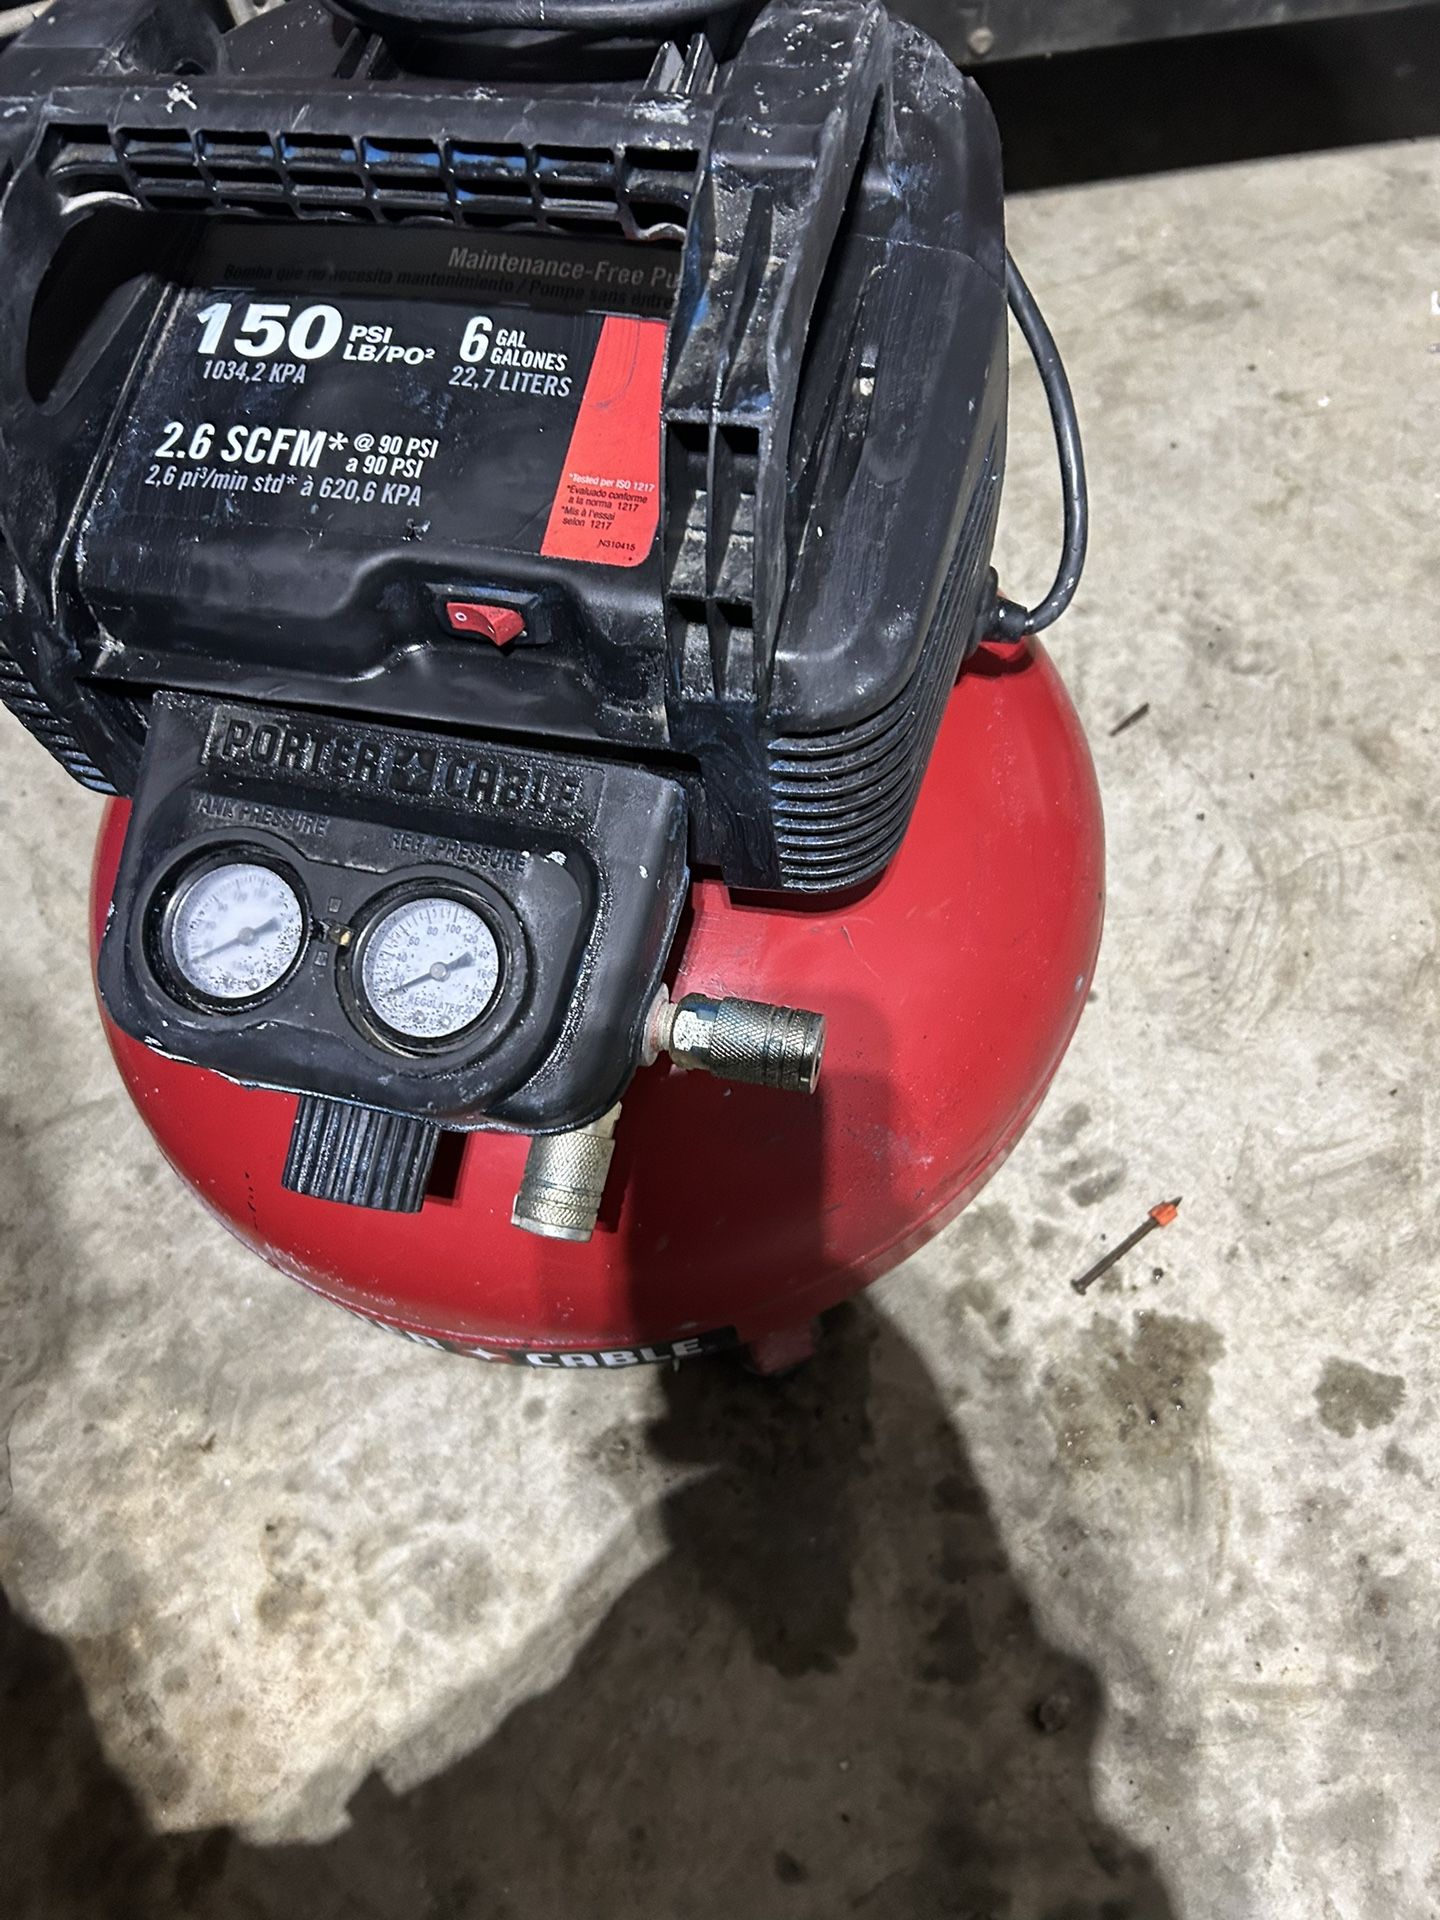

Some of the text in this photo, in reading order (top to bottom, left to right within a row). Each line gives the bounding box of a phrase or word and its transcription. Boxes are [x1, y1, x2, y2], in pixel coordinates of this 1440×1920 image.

[447, 247, 644, 285] Maintenance-Free
[224, 263, 272, 281] Bomba
[276, 266, 304, 282] que
[307, 268, 327, 281] no
[330, 266, 393, 285] necesita
[399, 270, 513, 293] mantenimiento
[529, 279, 585, 302] Pompe
[197, 303, 394, 360] 150 PSI
[459, 315, 527, 363] 6 GAL
[203, 360, 307, 384] 1034,2 KPA
[490, 349, 568, 373] GALONES
[448, 365, 573, 398] 22,7 LITERS
[155, 421, 216, 460] 2.6
[353, 433, 375, 453] @
[378, 434, 402, 456] 90
[405, 438, 440, 460] PSI
[363, 454, 388, 476] 90
[390, 459, 424, 480] PSI
[145, 464, 176, 488] 2,6
[300, 475, 314, 497] à
[318, 476, 378, 504] 620,6
[380, 481, 423, 507] KPA
[600, 477, 615, 488] per
[615, 478, 631, 490] ISO
[633, 481, 655, 492] 1217
[608, 489, 648, 504] conforme
[576, 495, 584, 505] la
[585, 498, 612, 509] norma
[617, 501, 639, 512] 1217
[580, 507, 587, 517] à
[562, 516, 612, 531] selon 1217
[598, 539, 636, 552] N310415
[222, 718, 384, 784] PORTER
[426, 926, 439, 936] 80
[446, 923, 462, 935] 100
[525, 1338, 702, 1368] CABLE
